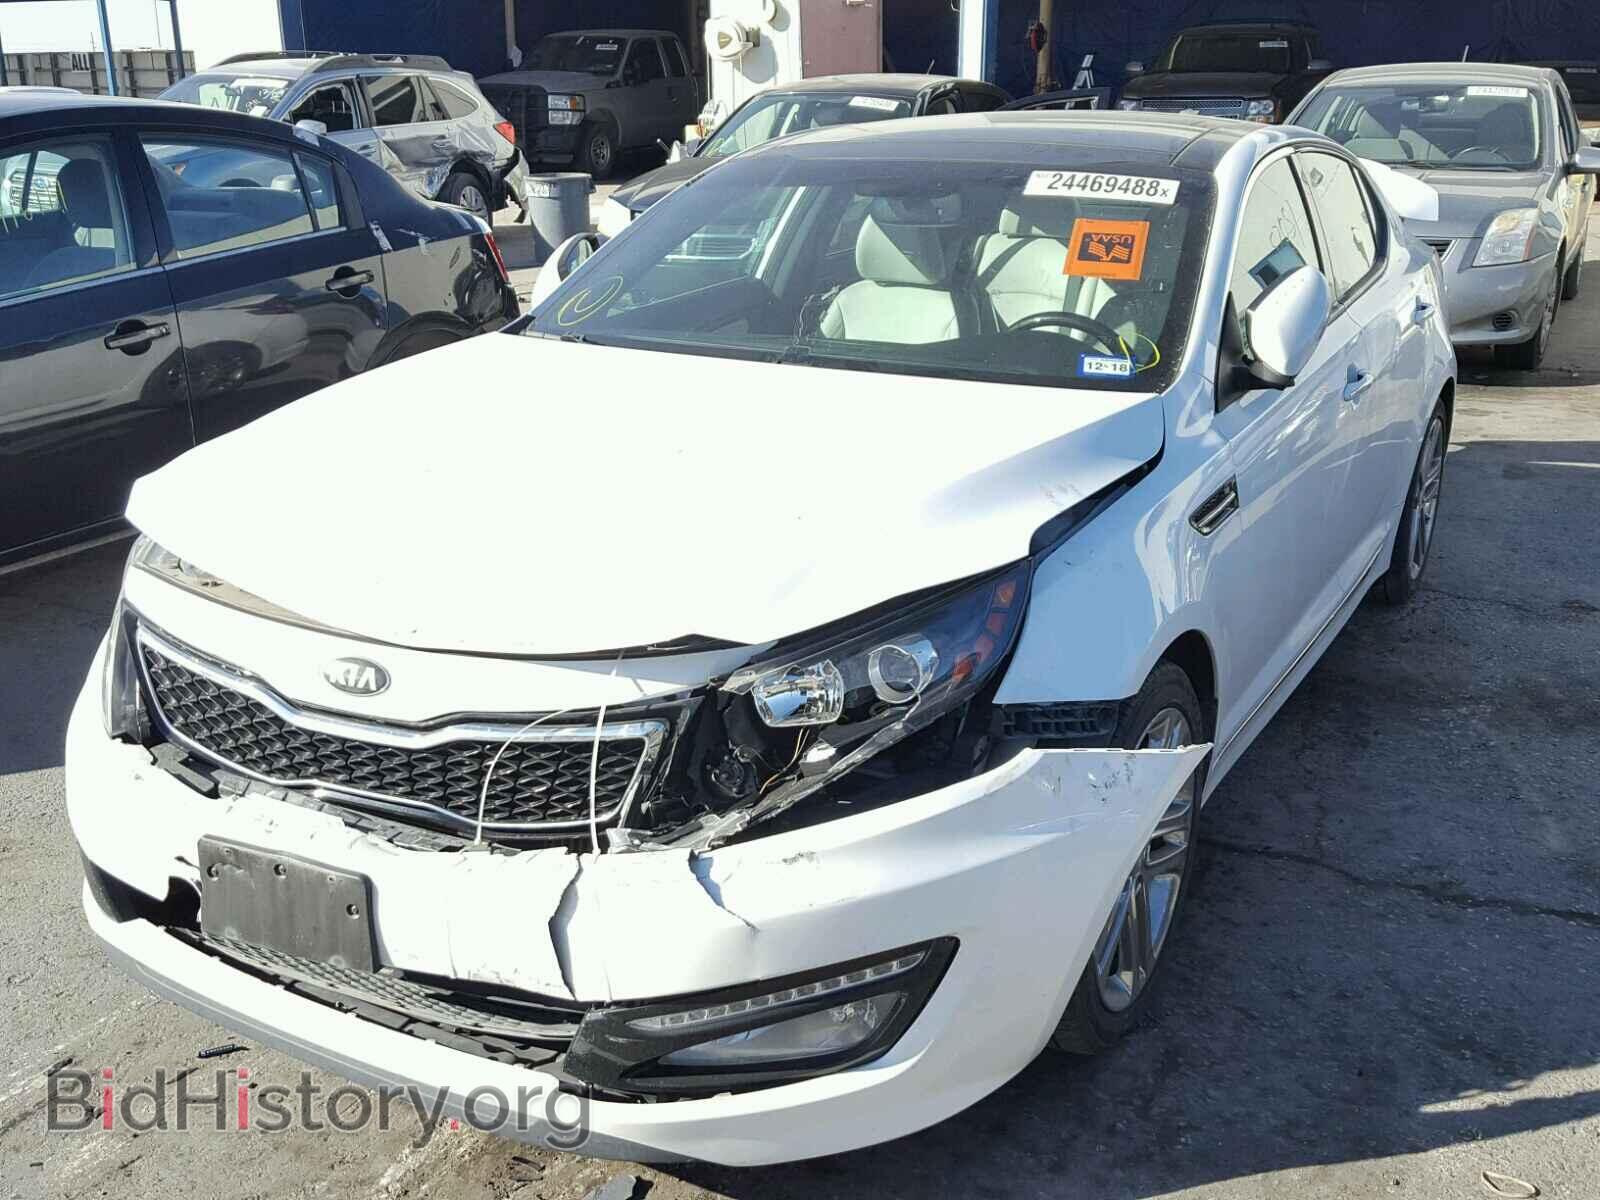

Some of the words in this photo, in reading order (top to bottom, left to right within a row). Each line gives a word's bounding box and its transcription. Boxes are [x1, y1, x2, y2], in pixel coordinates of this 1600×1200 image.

[72, 53, 90, 71] ALL
[1091, 233, 1132, 245] USAA
[326, 663, 377, 691] KIA
